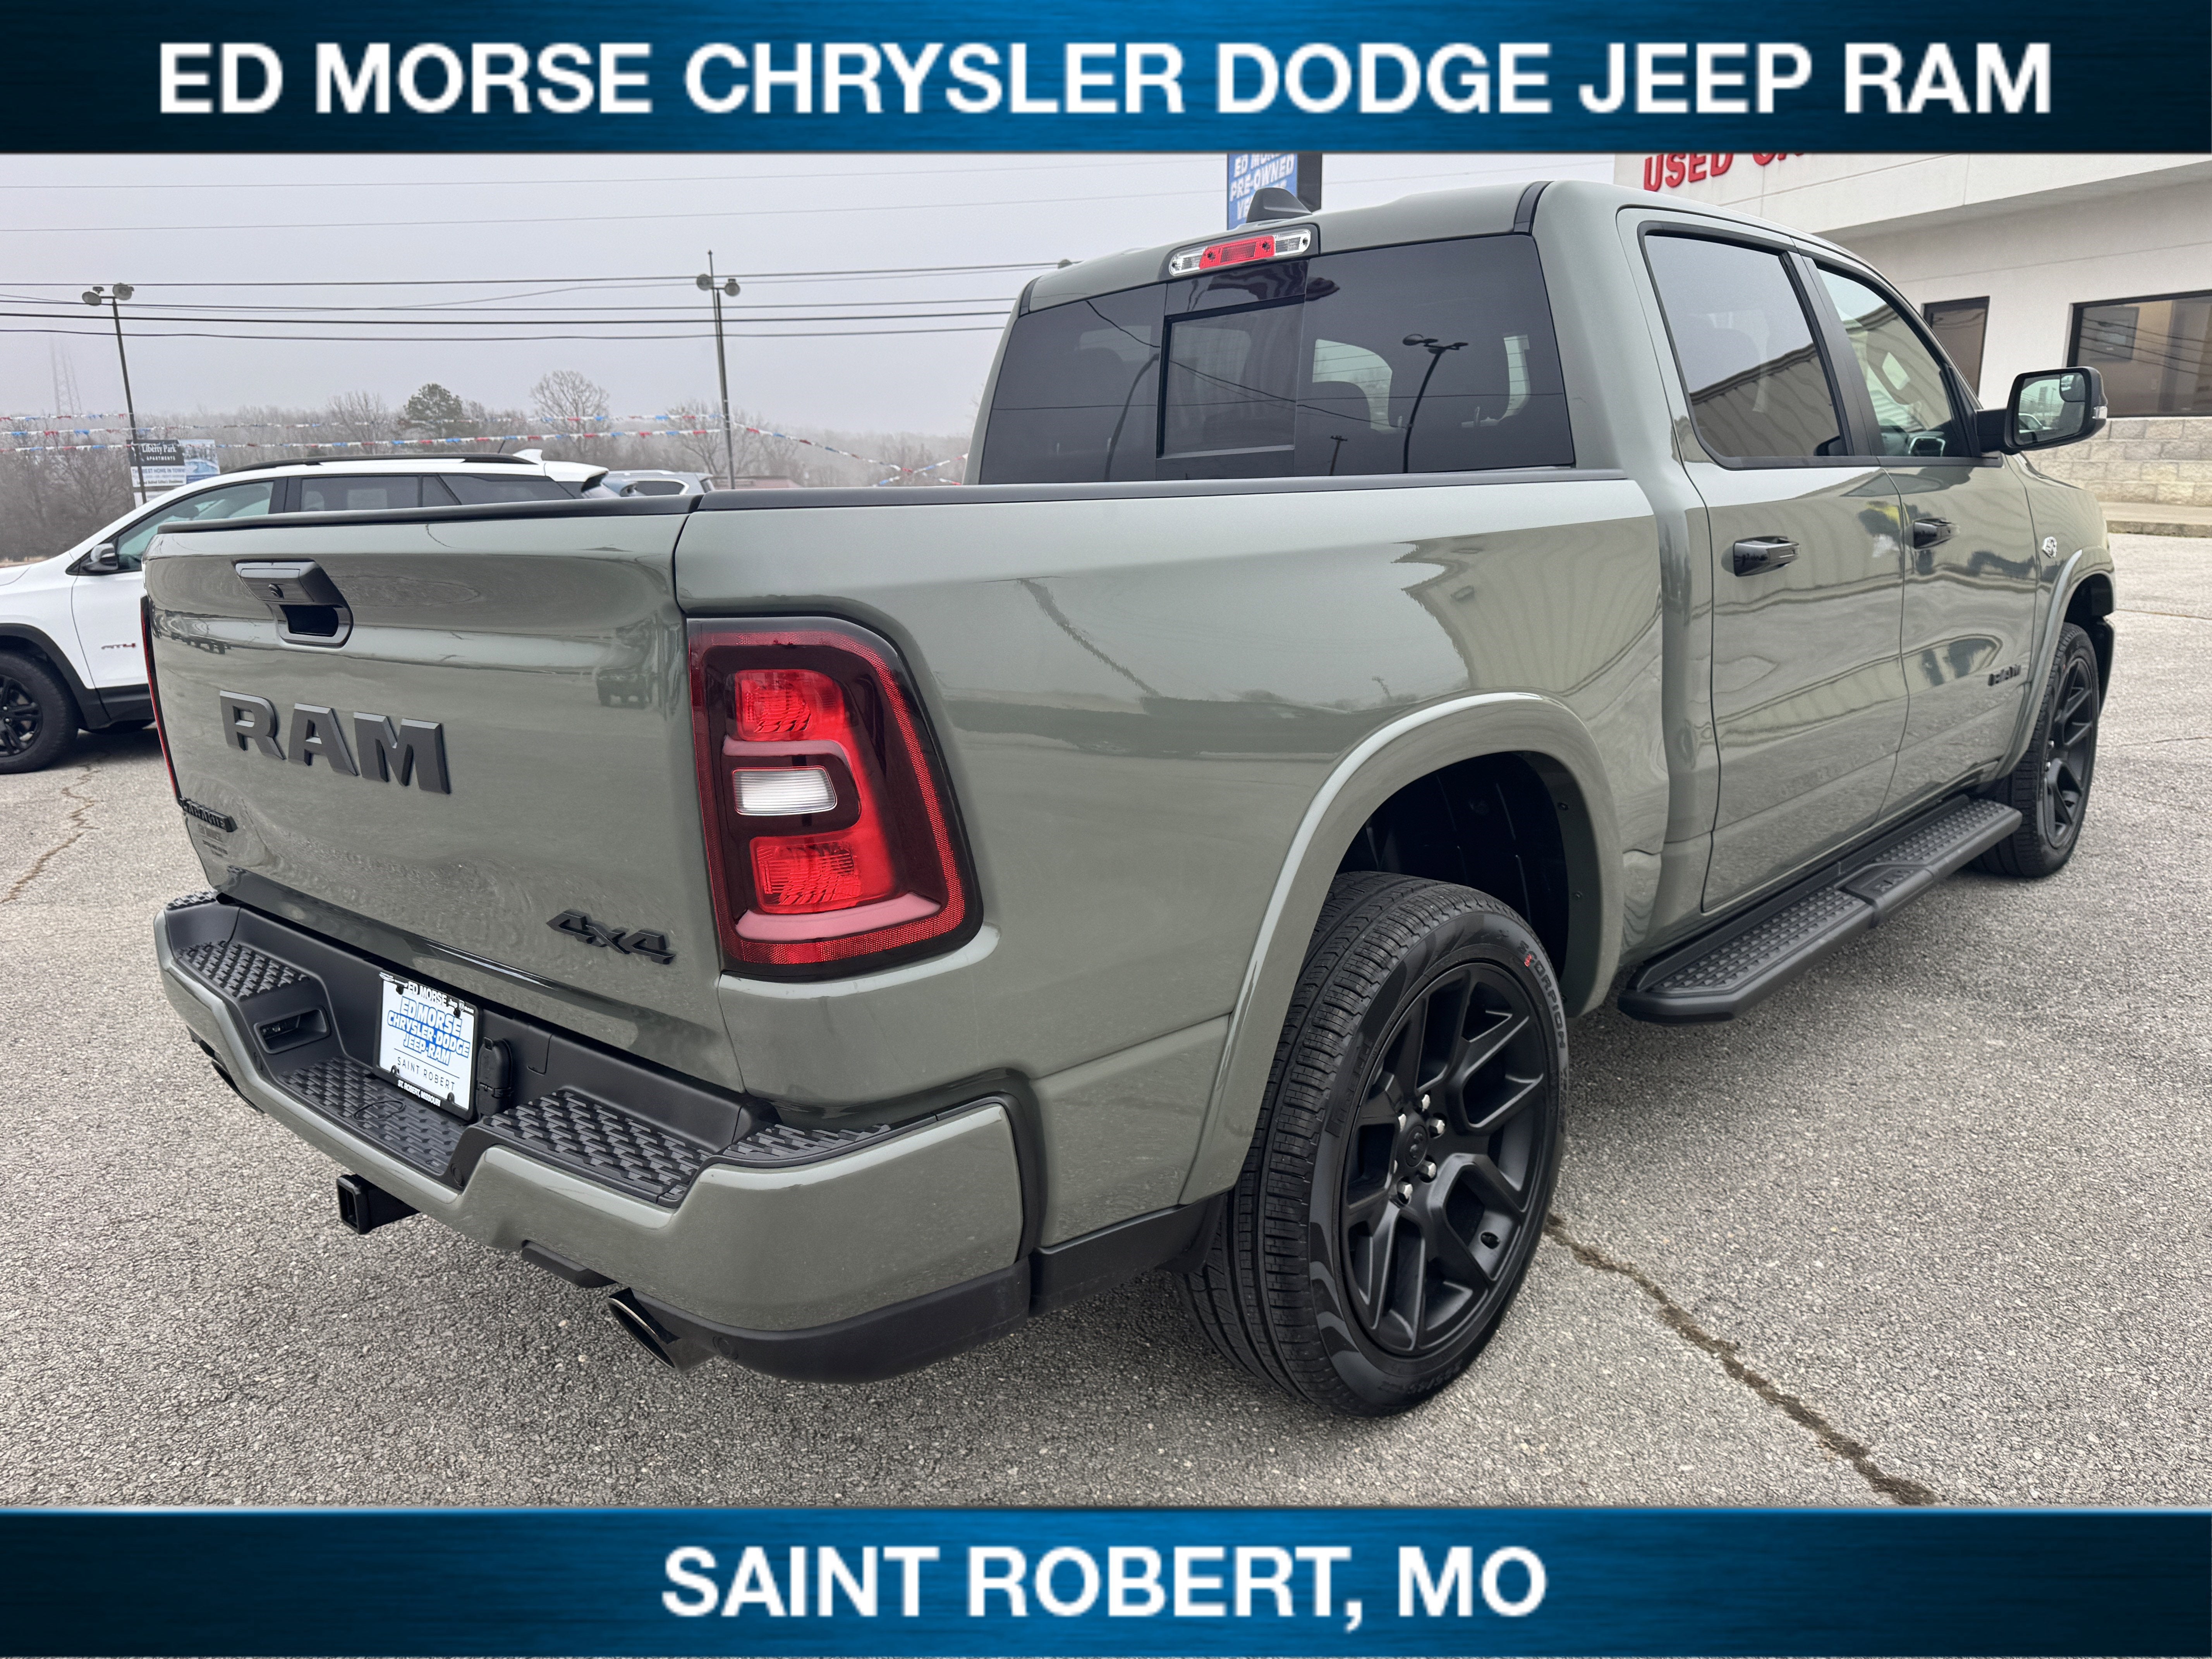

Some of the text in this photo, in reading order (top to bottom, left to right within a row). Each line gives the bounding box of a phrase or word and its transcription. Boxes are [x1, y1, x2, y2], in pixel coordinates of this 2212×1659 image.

[1230, 153, 1295, 201] PRE-OWNED
[1234, 153, 1249, 178] ED
[1644, 153, 1734, 192] USED
[163, 444, 177, 453] Park
[220, 690, 451, 795] RAM
[408, 981, 418, 995] ED
[419, 985, 447, 1006] MORSE
[400, 996, 462, 1037] ED MORSE
[397, 1056, 455, 1091] SAINT ROBERT
